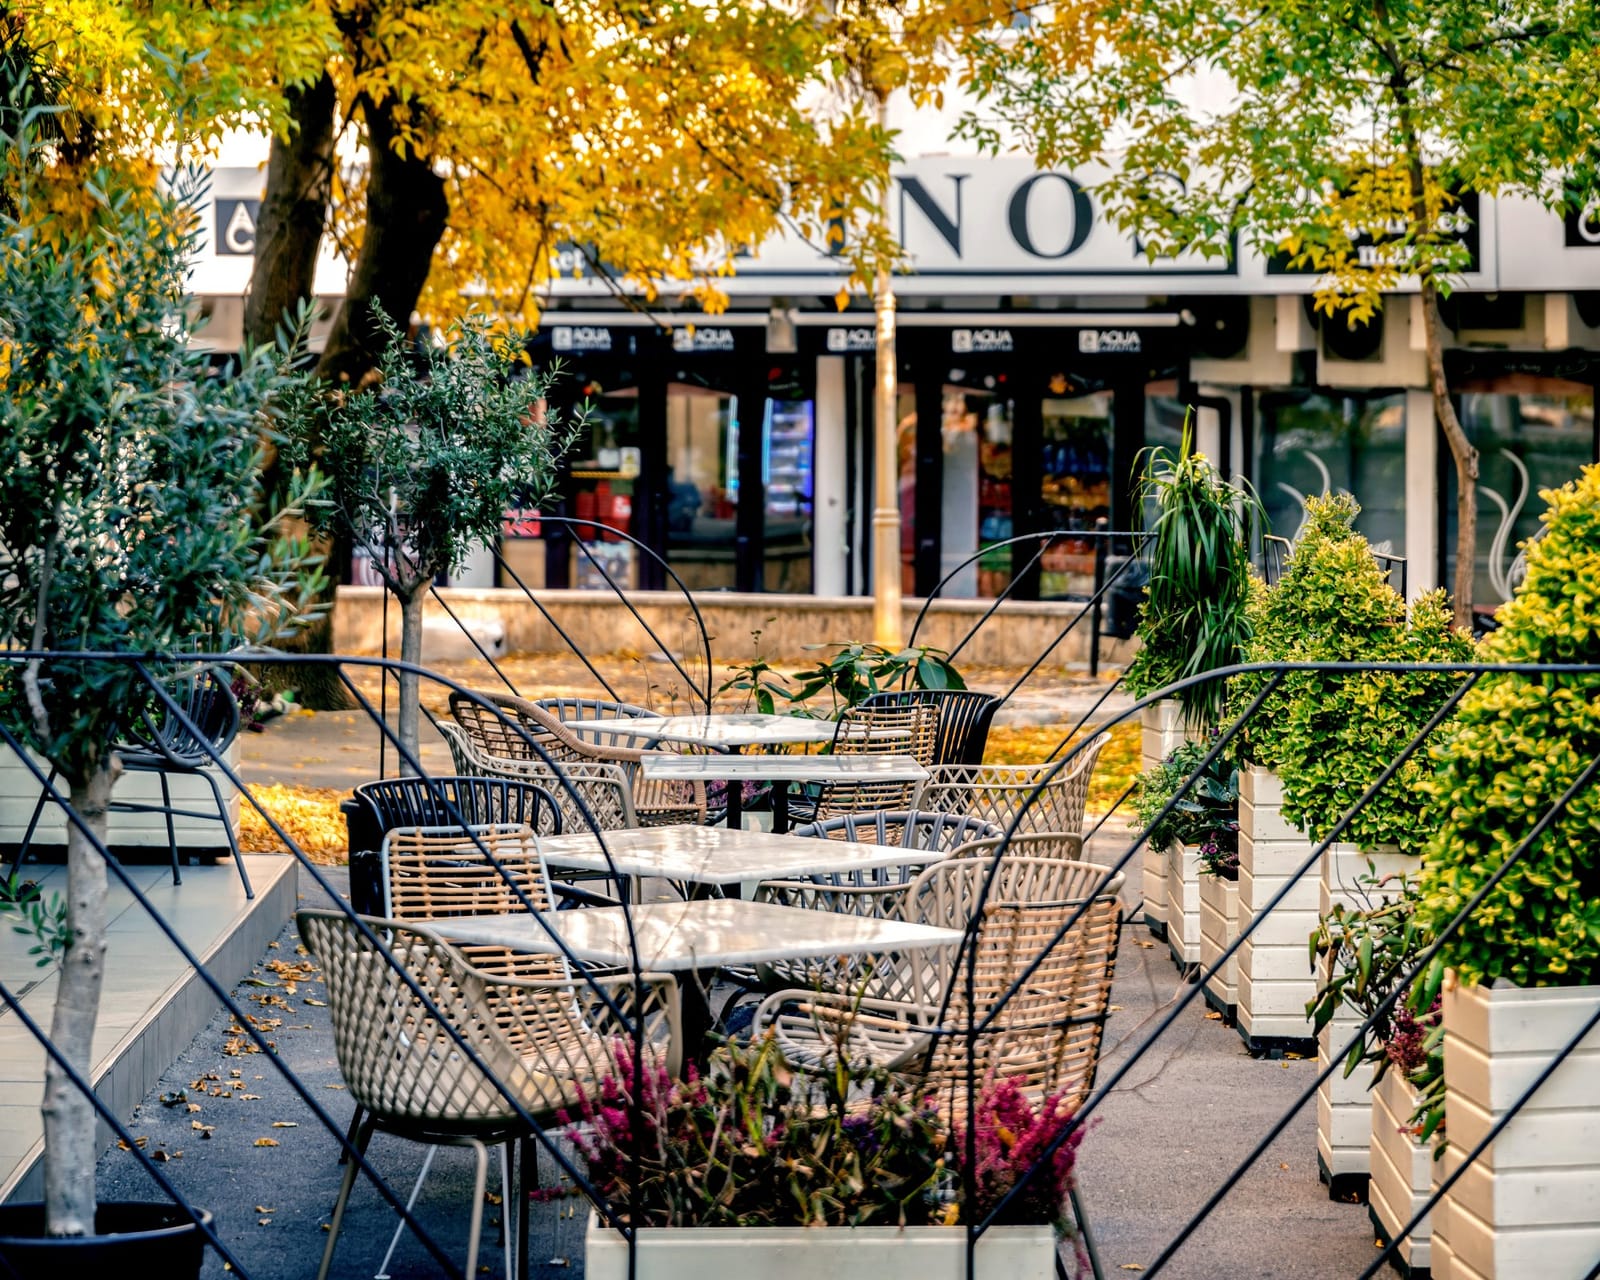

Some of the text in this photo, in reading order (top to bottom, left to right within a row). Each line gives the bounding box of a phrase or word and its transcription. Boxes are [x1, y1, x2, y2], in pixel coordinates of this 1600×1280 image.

[572, 327, 611, 343] AQUA
[695, 328, 734, 343] AQUA
[847, 329, 877, 343] AQU
[972, 329, 1013, 344] AQUA
[1099, 330, 1141, 345] AQUA
